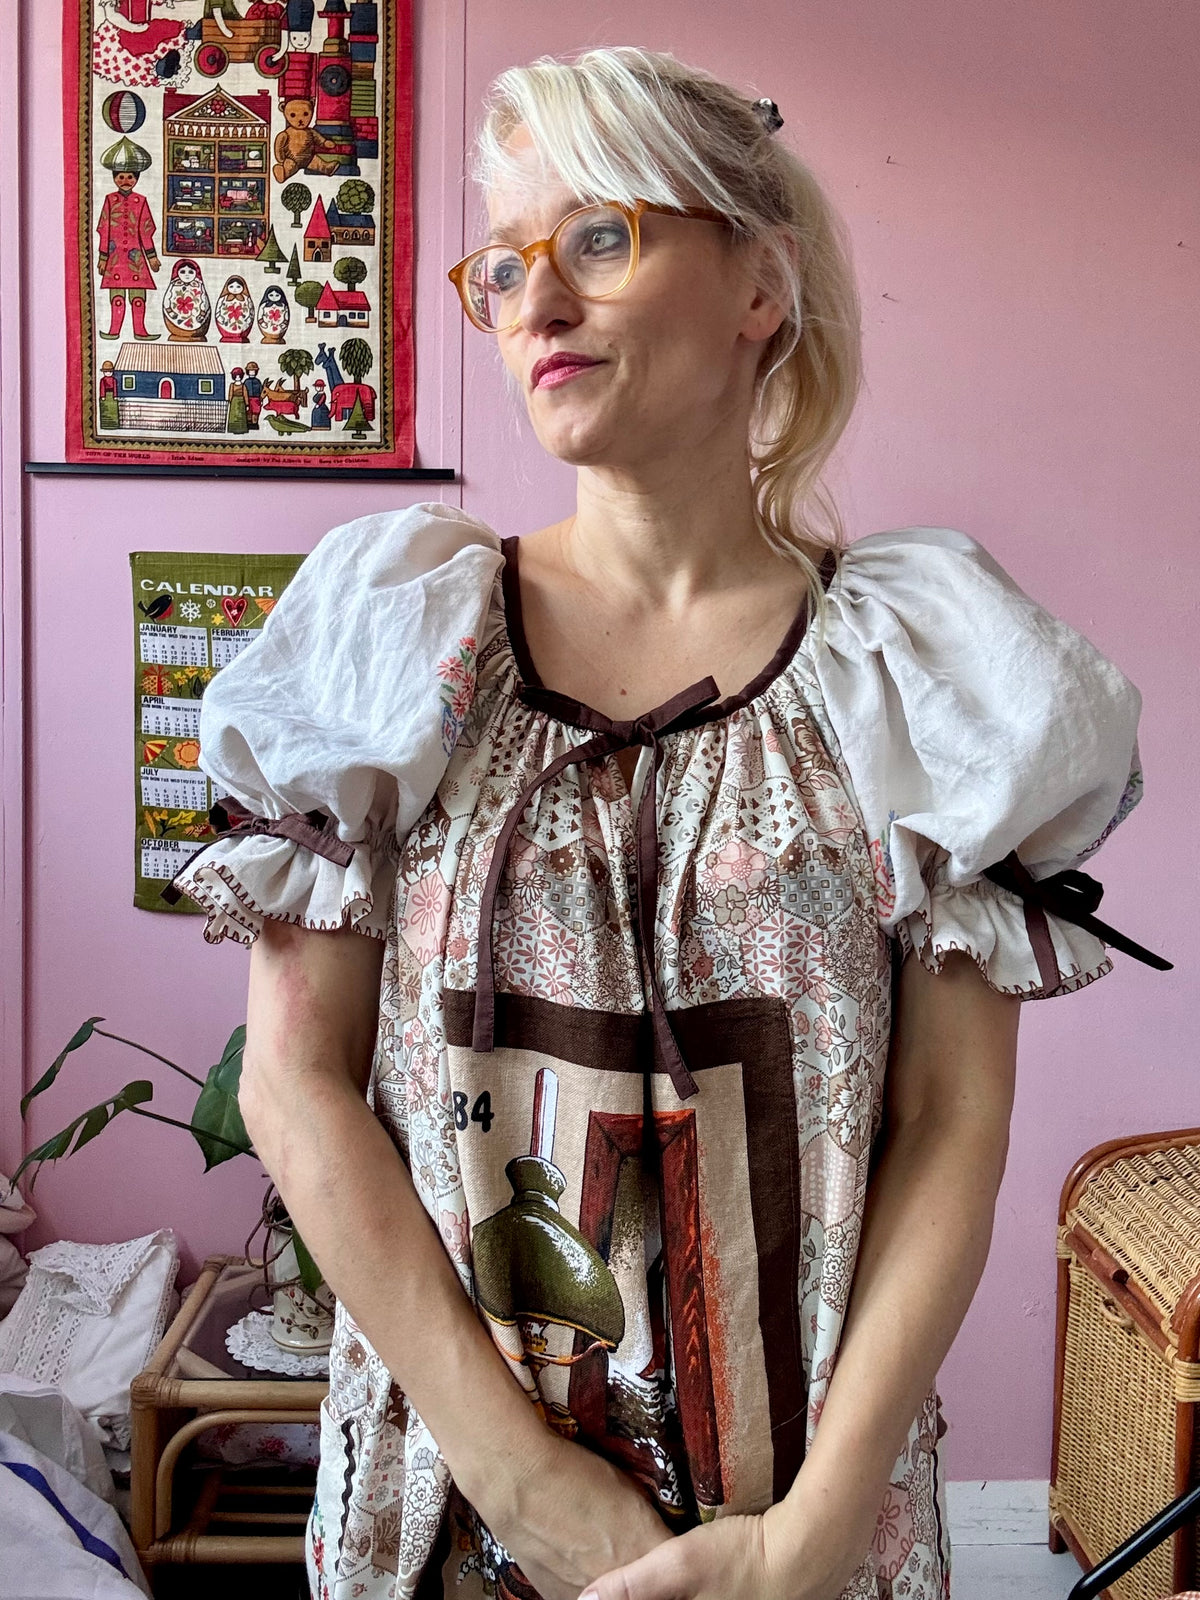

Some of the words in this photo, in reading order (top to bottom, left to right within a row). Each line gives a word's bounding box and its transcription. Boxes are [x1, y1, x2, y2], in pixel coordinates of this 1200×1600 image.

[141, 579, 273, 597] CALENDAR
[141, 625, 177, 633] JANUARY
[142, 839, 179, 848] OCTOBER
[453, 1091, 494, 1133] 84
